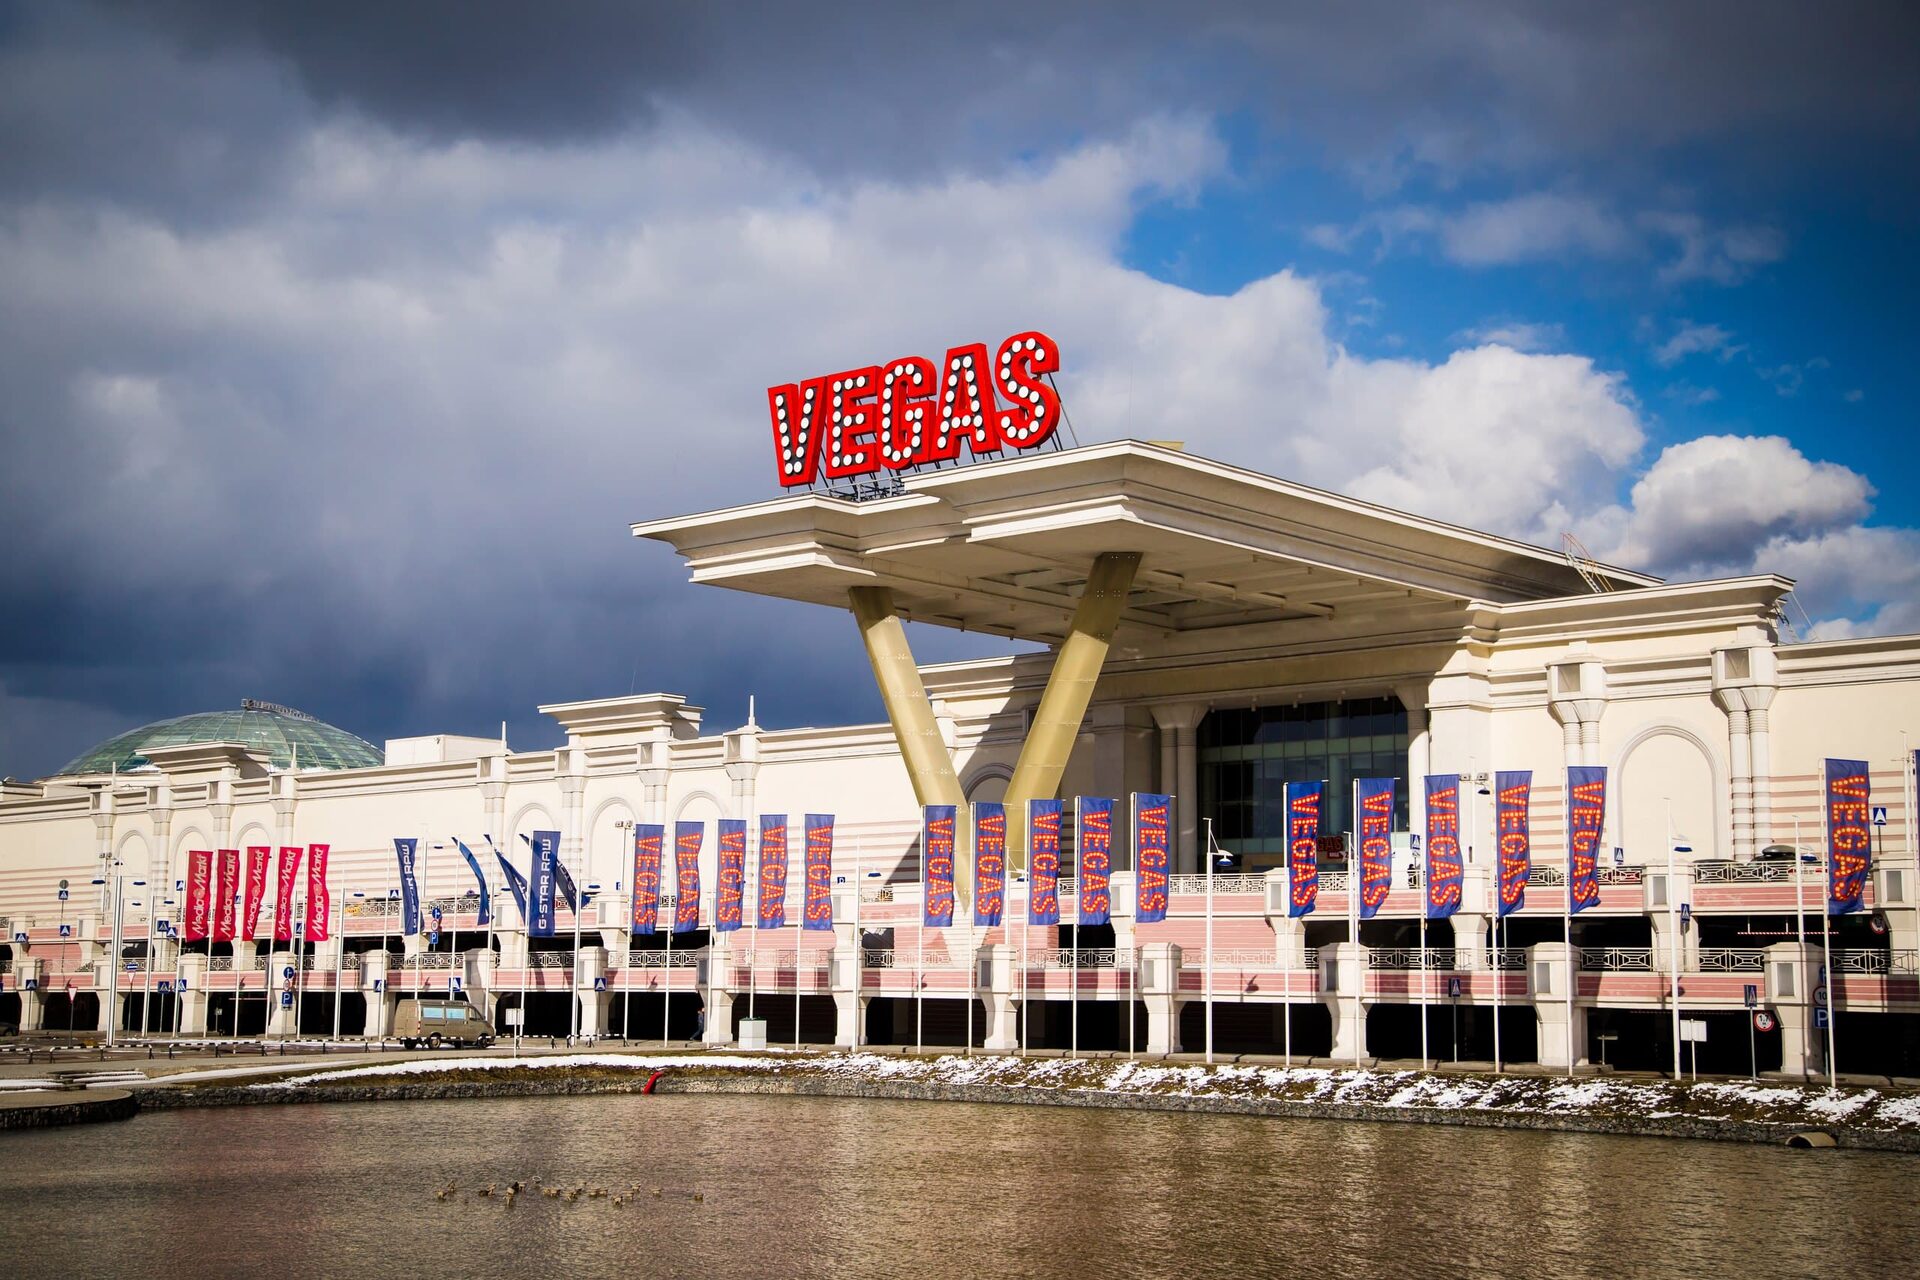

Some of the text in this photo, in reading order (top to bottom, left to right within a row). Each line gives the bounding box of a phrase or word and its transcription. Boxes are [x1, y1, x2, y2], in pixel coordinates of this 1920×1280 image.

[767, 331, 1061, 487] VEGAS
[538, 839, 552, 930] G-STAR RAW
[635, 837, 660, 924] VEGAS
[678, 834, 700, 922] VEGAS
[719, 832, 743, 922] VEGAS
[761, 826, 785, 918] VEGAS
[807, 827, 831, 920] VEGAS
[928, 818, 953, 916] VEGAS
[977, 816, 1005, 914] VEGAS
[1032, 813, 1059, 914] VEGAS
[1082, 811, 1110, 913] VEGAS
[1139, 807, 1166, 911] VEGAS
[1291, 793, 1320, 906] VEGAS
[1362, 791, 1391, 906] VEGAS
[1428, 787, 1461, 907] VEGAS
[1499, 784, 1528, 904] VEGAS
[1573, 780, 1604, 903] VEGAS
[1831, 776, 1869, 900] VEGAS
[283, 993, 291, 1004] P
[1817, 1009, 1829, 1027] P
